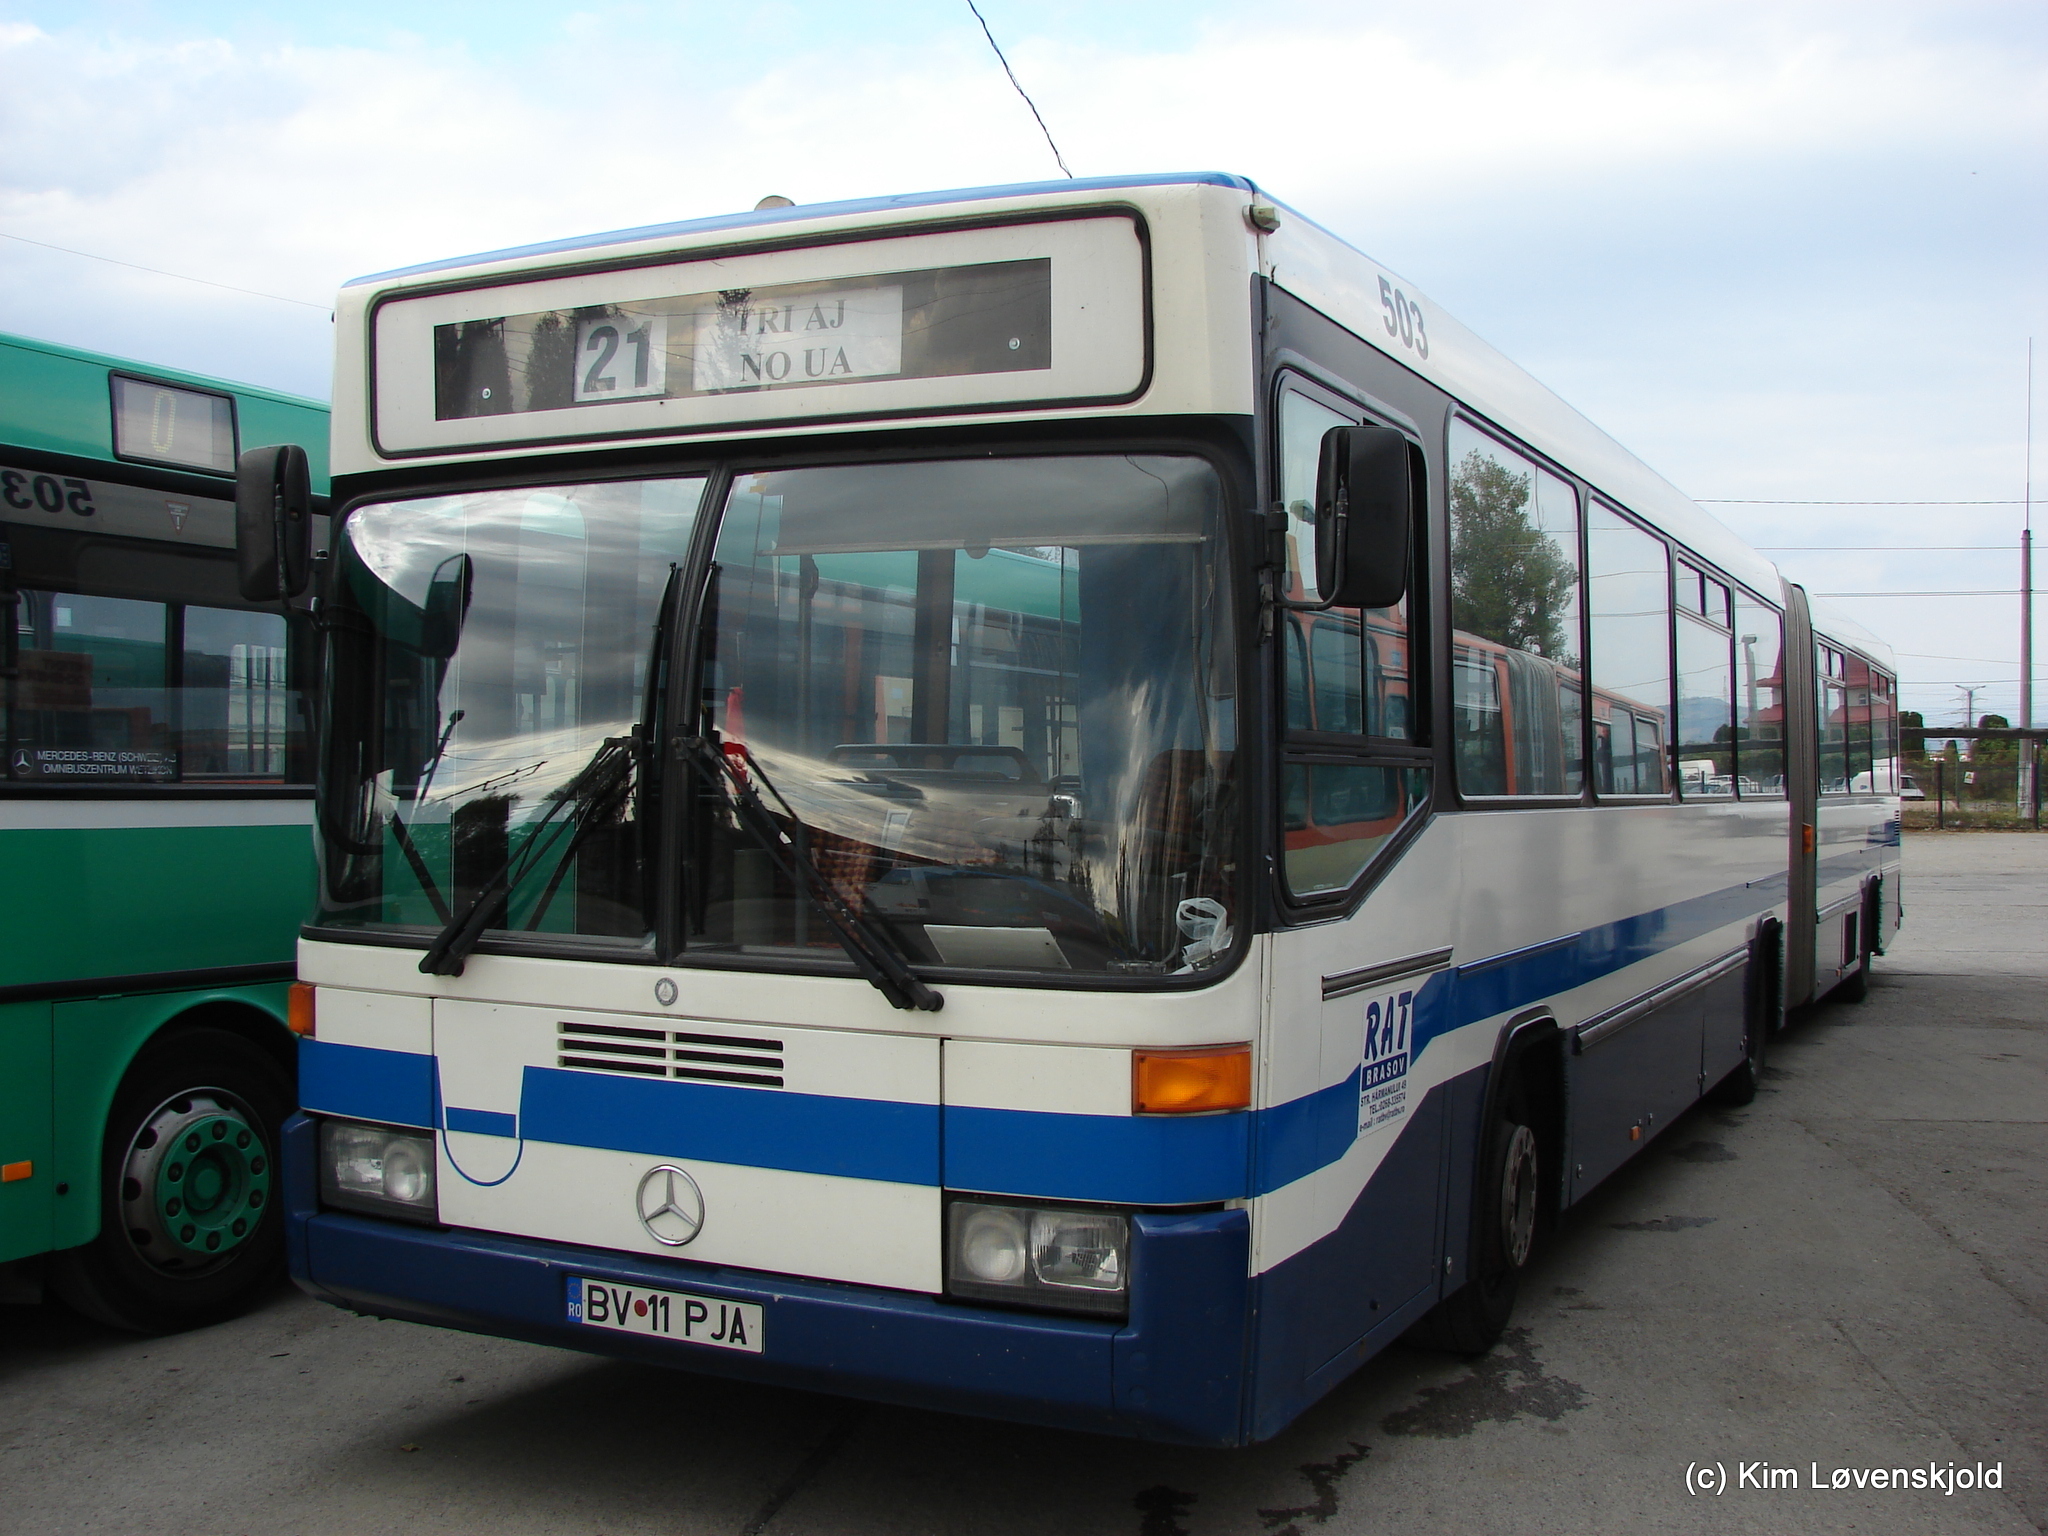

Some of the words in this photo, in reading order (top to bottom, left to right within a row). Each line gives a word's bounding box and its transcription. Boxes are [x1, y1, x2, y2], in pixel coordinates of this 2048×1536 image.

[804, 299, 847, 331] AJ
[1378, 274, 1428, 360] 503
[583, 320, 653, 393] 21
[740, 351, 792, 382] NO
[803, 346, 853, 377] UA
[152, 390, 176, 453] 0
[37, 751, 116, 762] MERCEDES-BENZ
[43, 764, 127, 774] OMNIBUSZENTRUM
[1364, 990, 1412, 1061] RAT
[1366, 1057, 1405, 1085] BRASOV
[568, 1302, 582, 1318] RO
[588, 1284, 632, 1326] BV
[648, 1294, 670, 1333] 11
[685, 1299, 748, 1345] PJA
